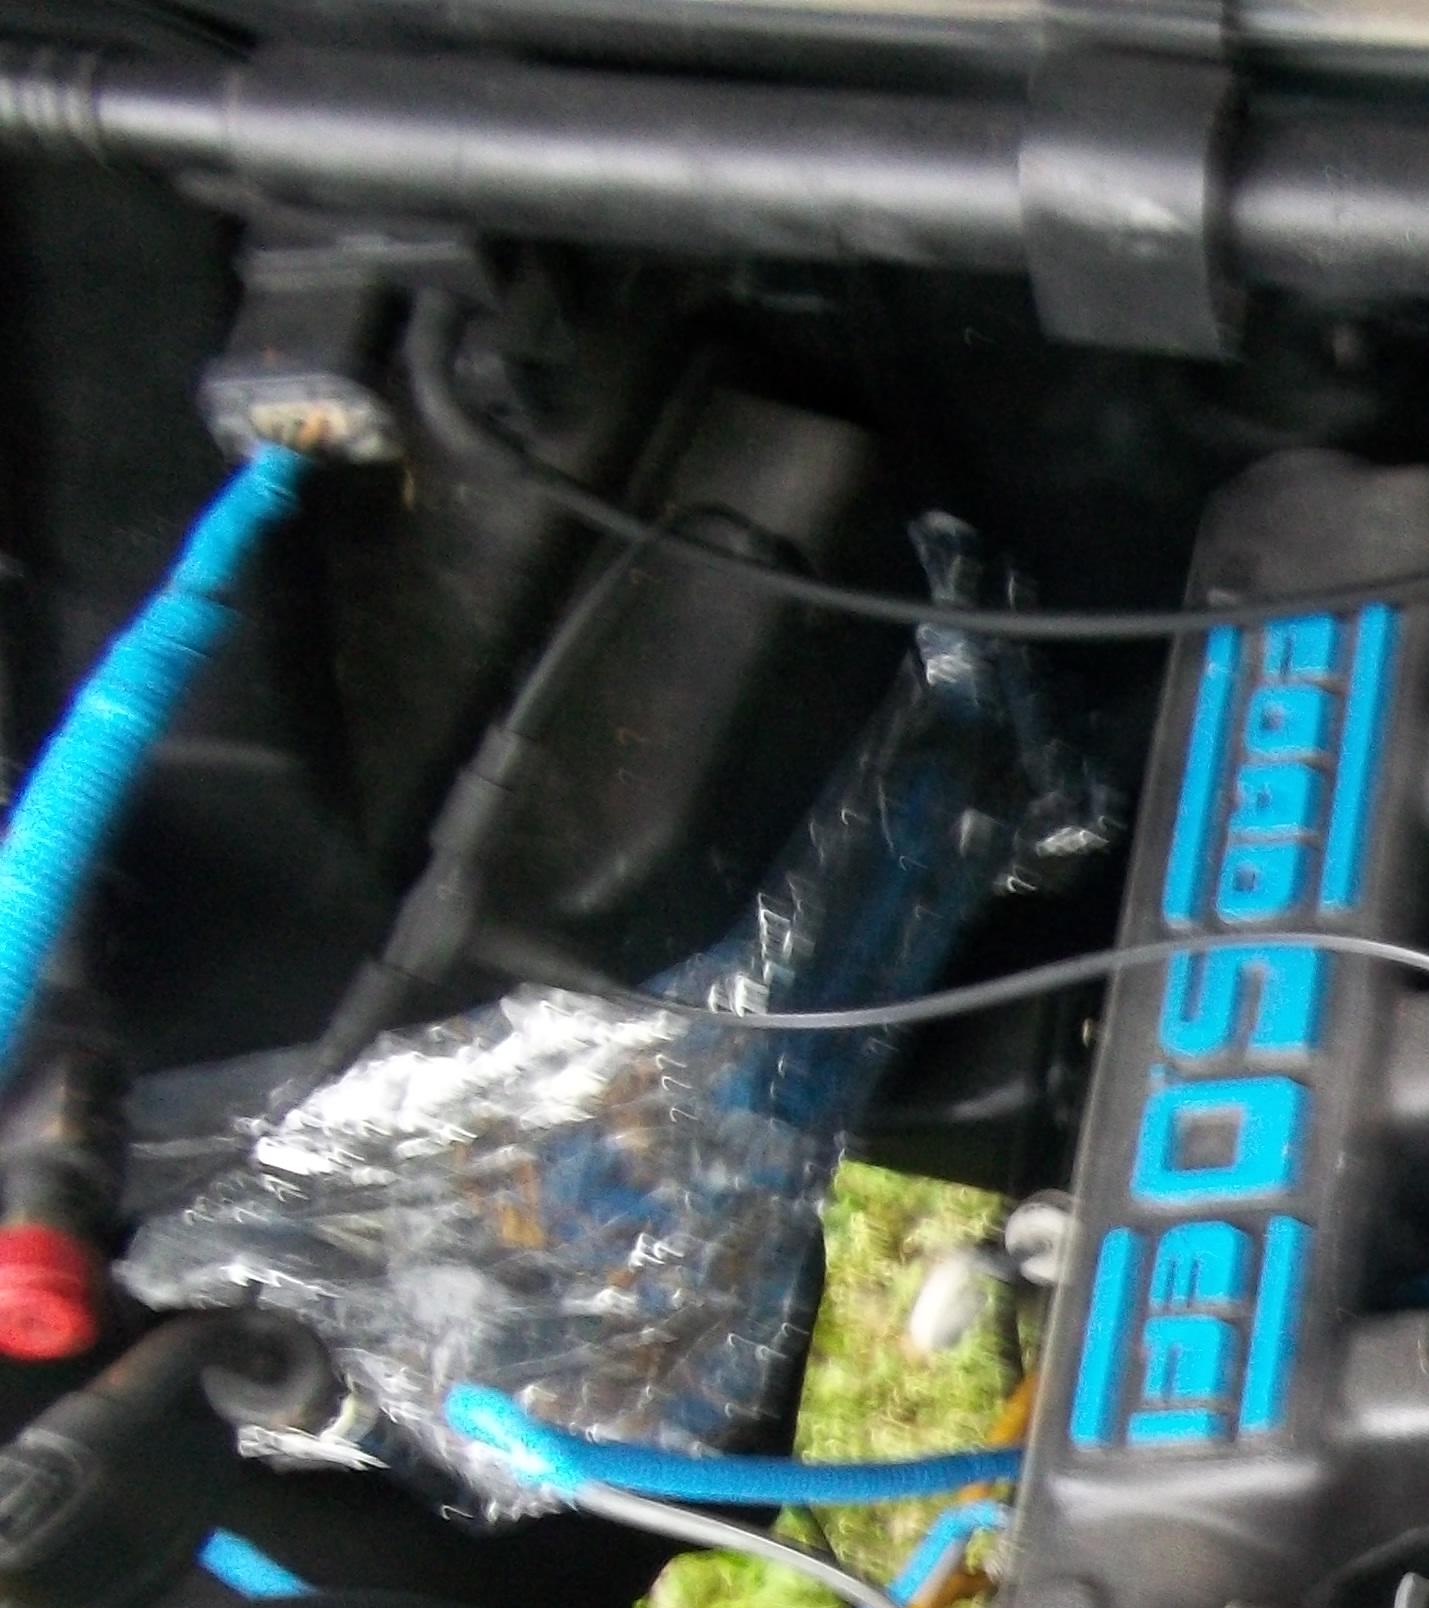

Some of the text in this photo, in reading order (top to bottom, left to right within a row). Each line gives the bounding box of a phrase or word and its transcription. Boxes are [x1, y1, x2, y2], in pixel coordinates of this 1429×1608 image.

[1126, 612, 1338, 1446] FORD 5.0 EFI
